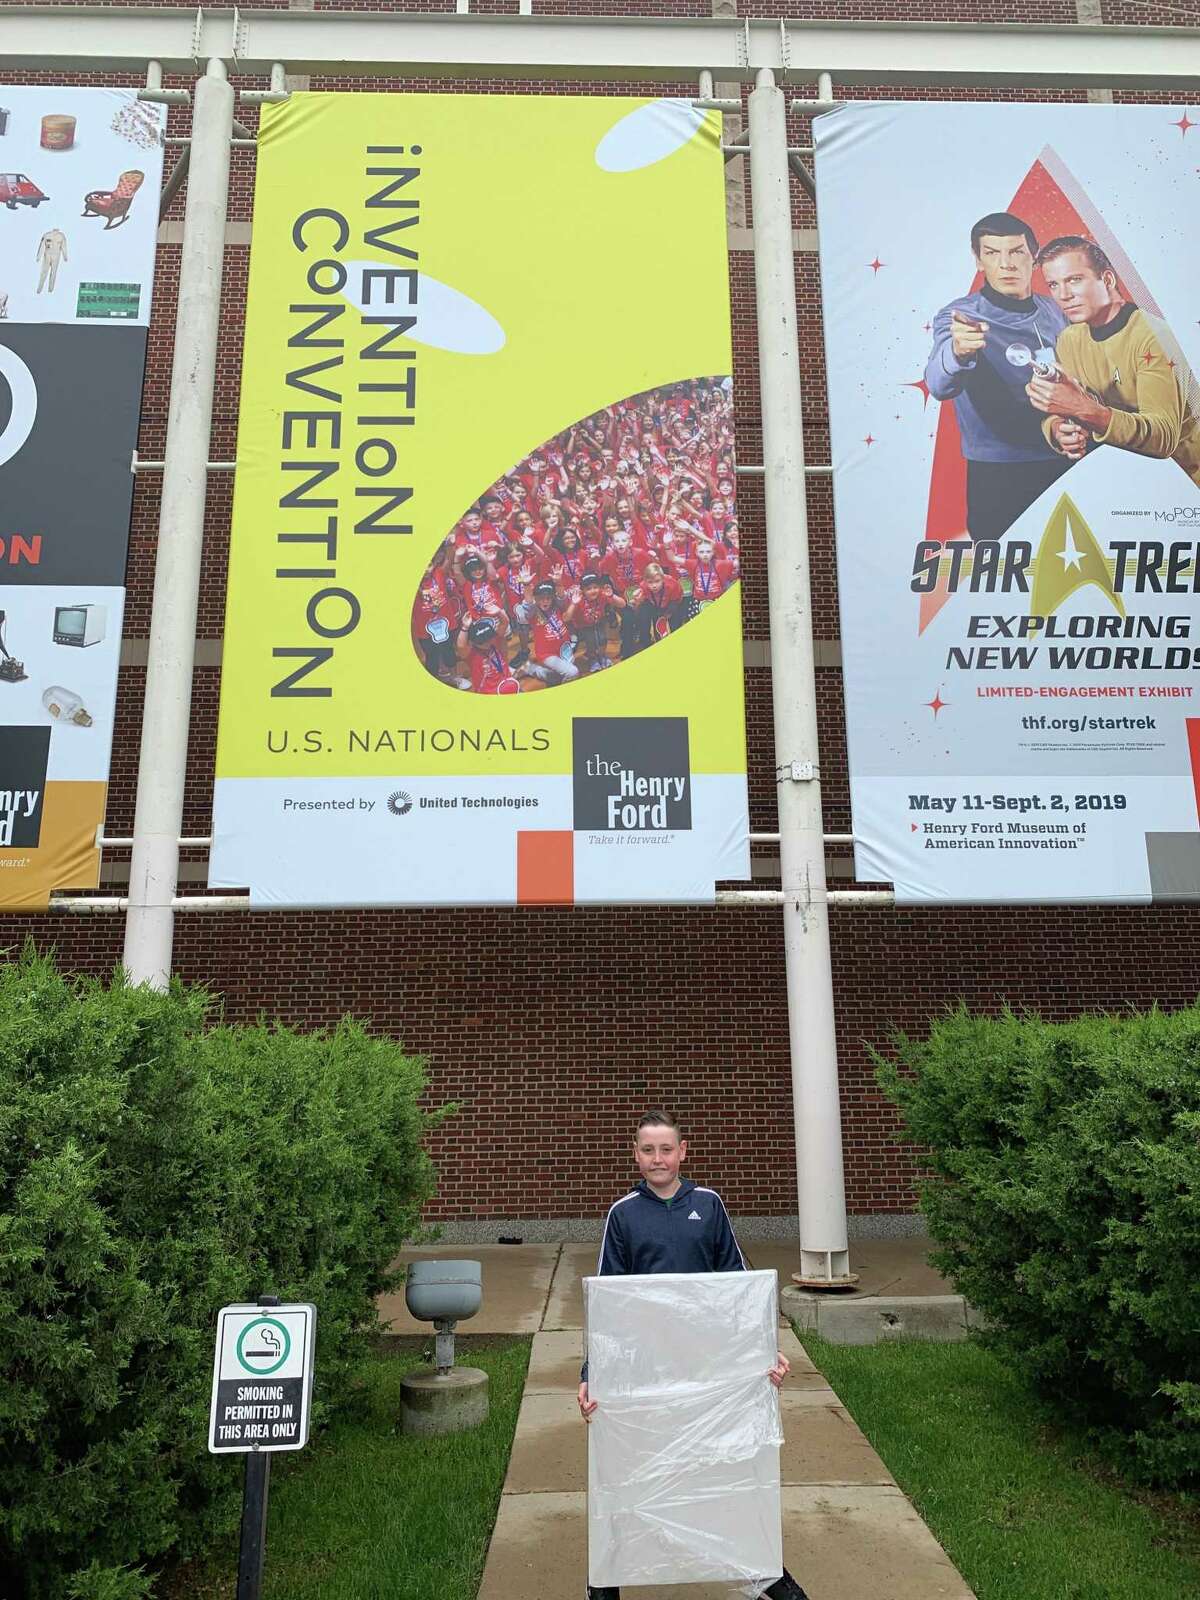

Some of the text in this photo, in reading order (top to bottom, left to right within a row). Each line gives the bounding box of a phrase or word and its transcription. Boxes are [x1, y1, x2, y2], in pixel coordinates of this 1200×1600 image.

[0, 535, 42, 564] N
[910, 541, 1200, 593] STAR TRE
[967, 615, 1191, 638] EXPLORING
[946, 647, 1038, 670] NEW
[977, 686, 1193, 698] LIMITED-ENGAGEMENT EXHIBIT
[1022, 715, 1156, 733] thf.org/startrek
[267, 729, 550, 753] U.S. NATIONALS
[586, 754, 621, 776] the
[620, 769, 686, 801] Henry
[283, 796, 539, 812] Presented by United Technologies
[607, 795, 667, 829] Ford
[908, 795, 1127, 813] May 11-Sept. 2, 2019
[923, 823, 1087, 836] Henry Ford Museum of
[588, 835, 613, 845] Take
[615, 835, 625, 845] it
[924, 838, 995, 849] American
[237, 1386, 284, 1401] SMOKING
[225, 1404, 293, 1420] PERMITTED IN
[219, 1422, 297, 1439] THIS AREA ONLY
